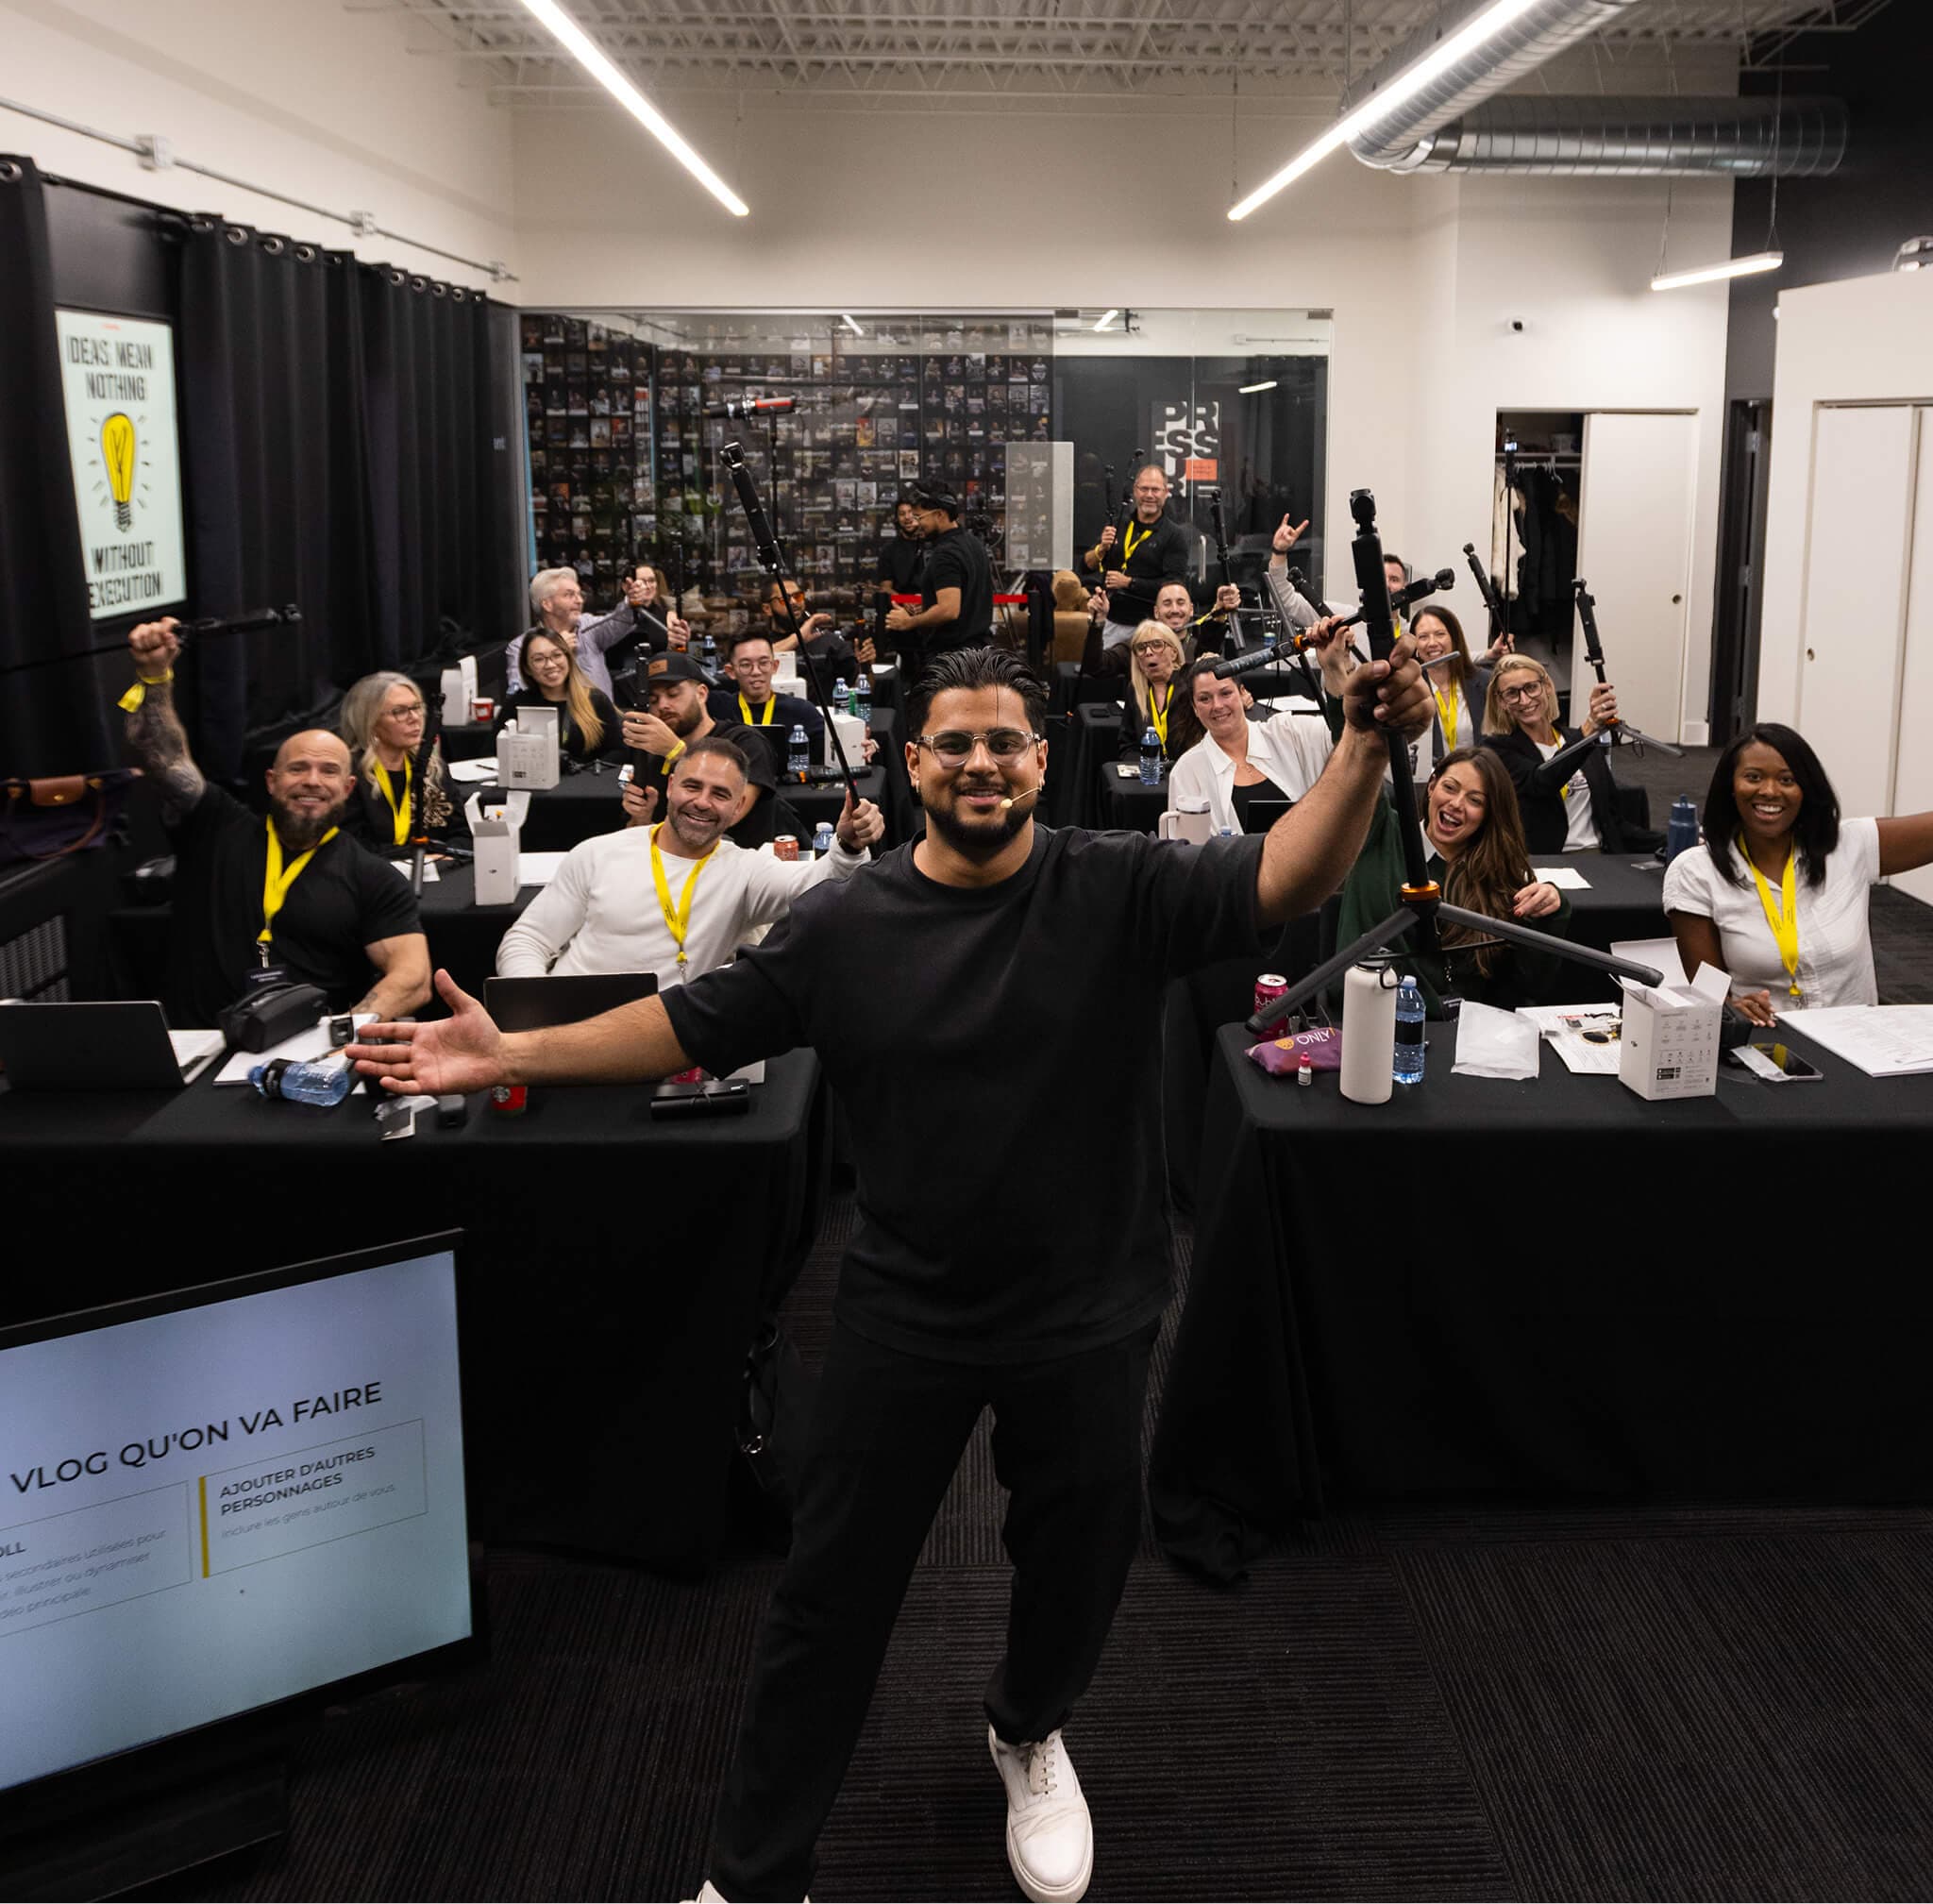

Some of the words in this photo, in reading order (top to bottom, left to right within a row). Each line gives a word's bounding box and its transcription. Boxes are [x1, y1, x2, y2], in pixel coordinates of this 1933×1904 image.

[66, 335, 109, 366] IDEAS
[114, 342, 153, 370] MEAN
[85, 372, 145, 401] NOTHING
[91, 541, 154, 574] WITHOUT
[10, 1452, 109, 1493] VLOG
[119, 1420, 229, 1469] QU'ON
[239, 1408, 283, 1436] VA
[293, 1382, 382, 1423] FAIRE
[219, 1469, 295, 1499] AJOUTER
[299, 1446, 376, 1476] D'AUTRES
[221, 1473, 344, 1516] PERSONNAGES
[313, 1496, 350, 1514] autour
[352, 1491, 368, 1503] de
[136, 1530, 166, 1546] pour
